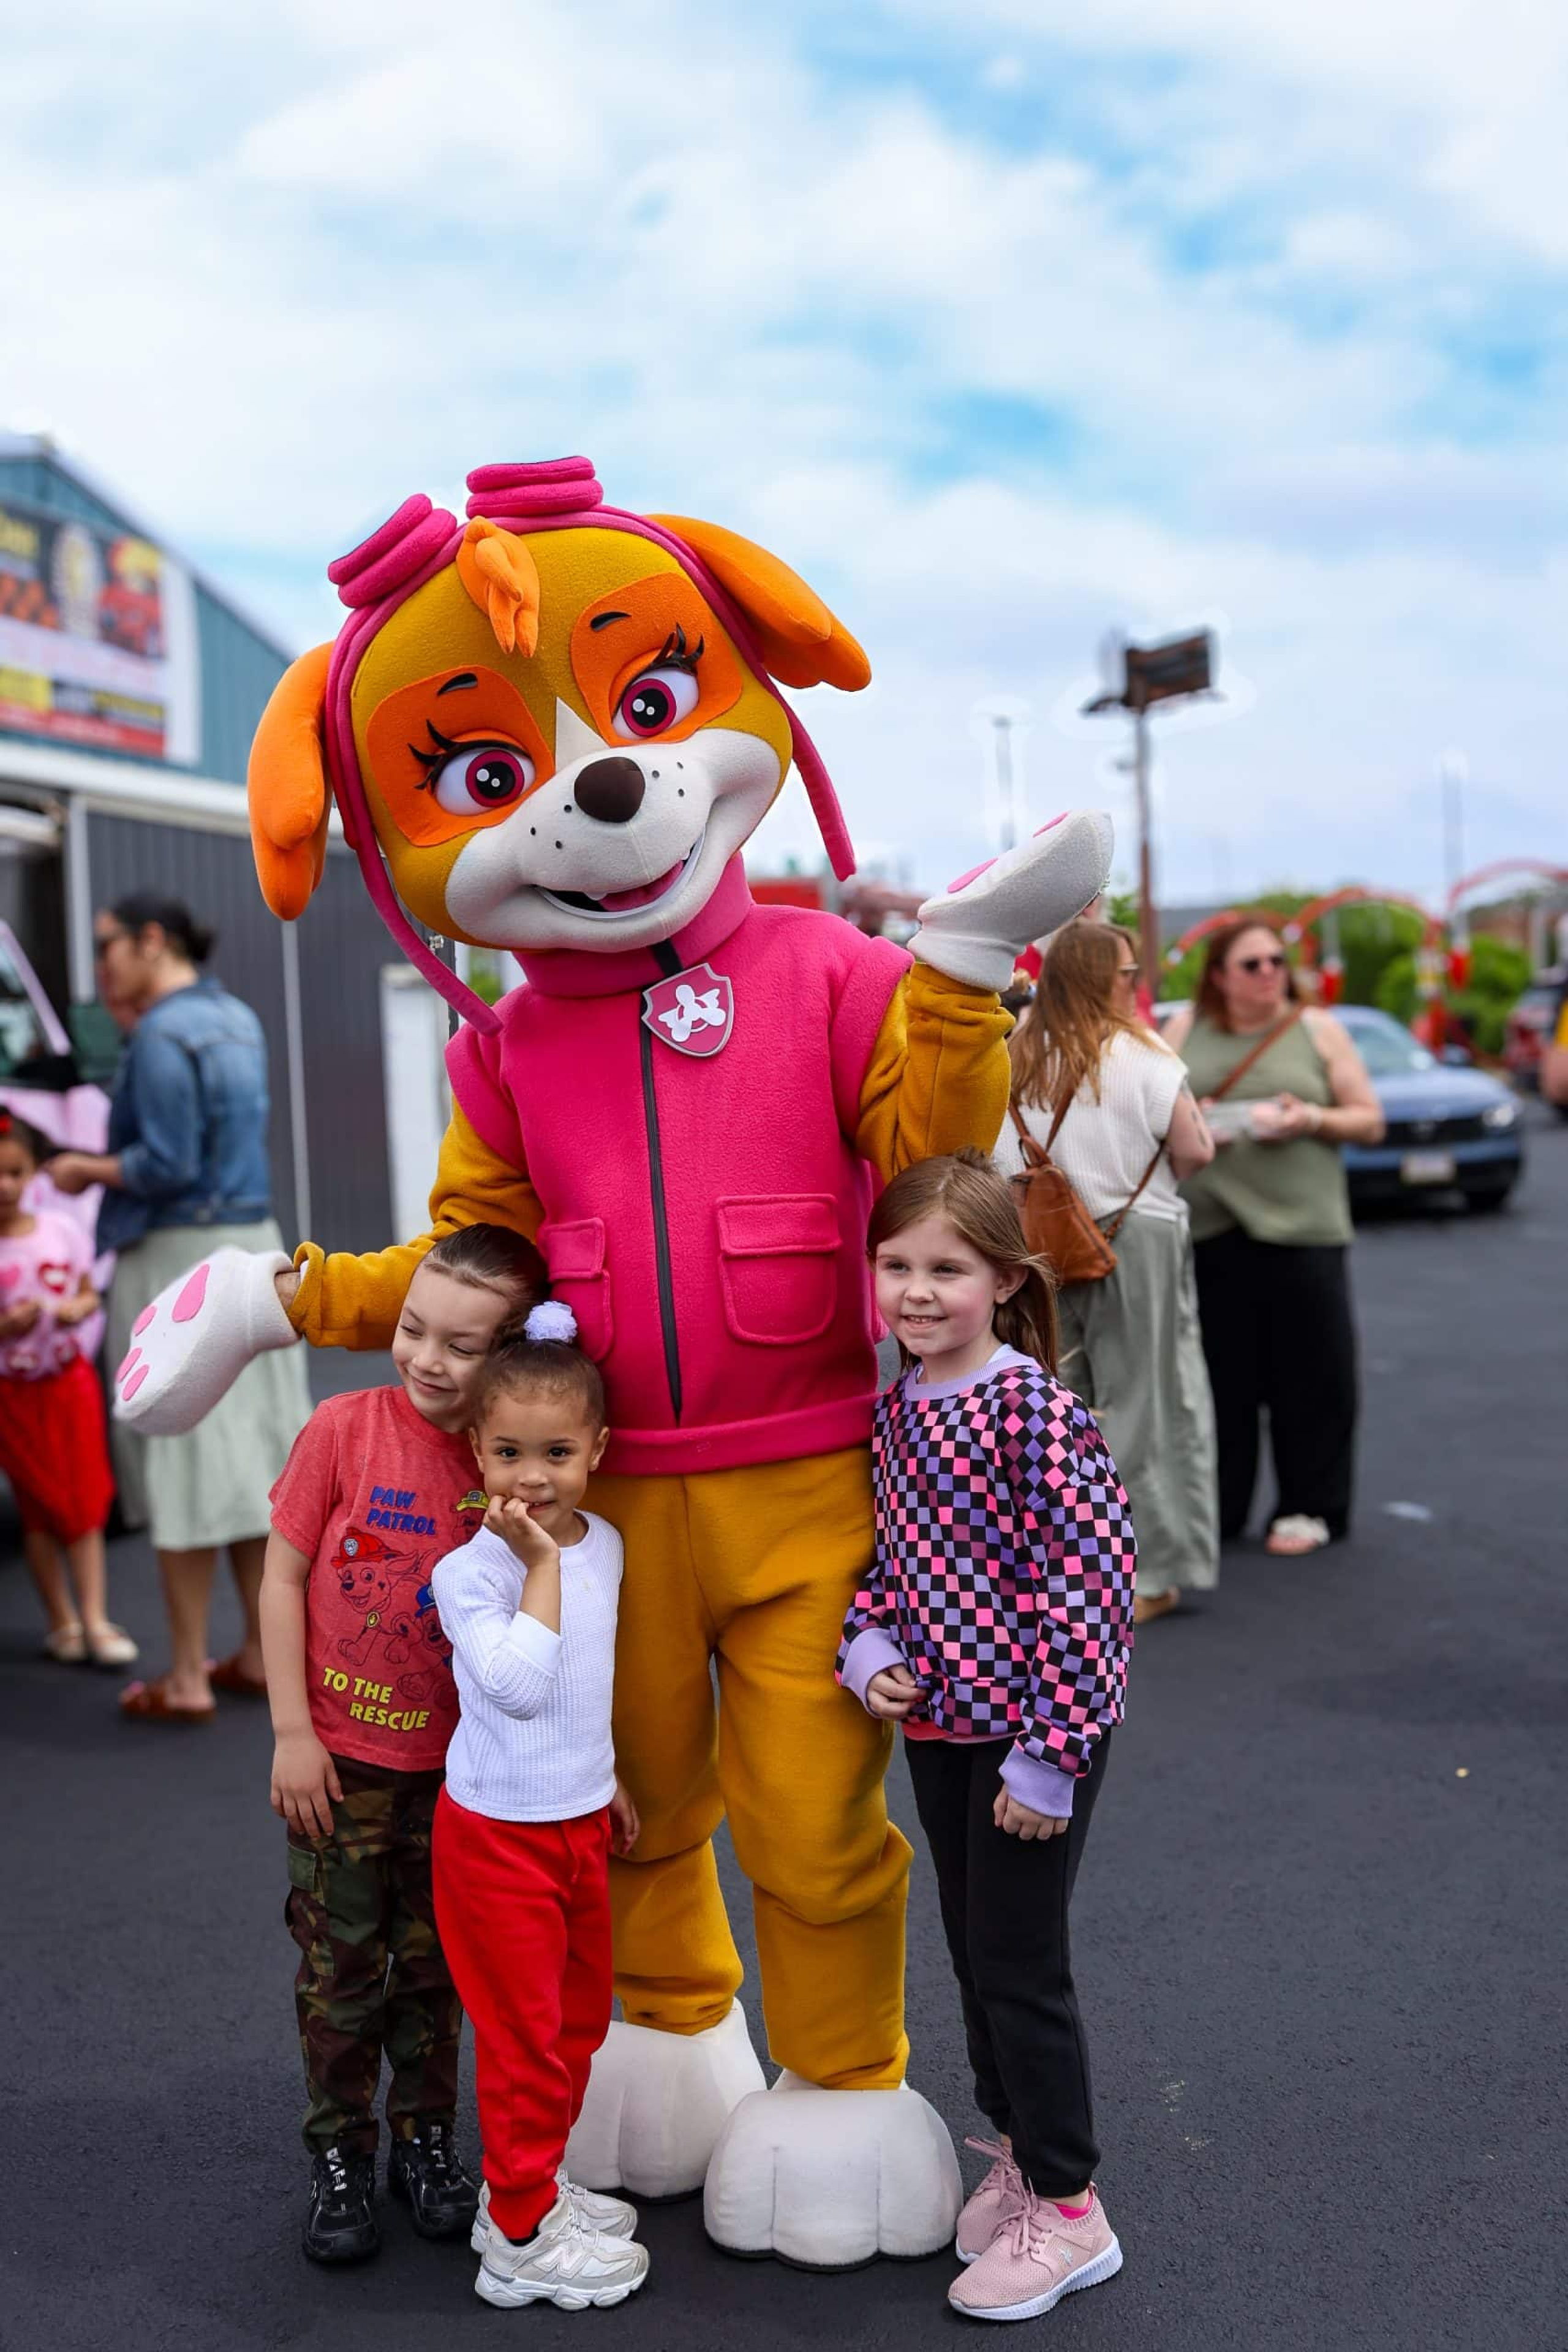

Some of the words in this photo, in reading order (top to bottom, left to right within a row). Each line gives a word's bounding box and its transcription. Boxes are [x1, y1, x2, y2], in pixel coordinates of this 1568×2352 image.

[369, 1486, 416, 1509] PAW
[366, 1508, 437, 1535] PATROL
[323, 1666, 349, 1692] TO
[353, 1677, 393, 1704] THE
[349, 1702, 430, 1731] RESCUE
